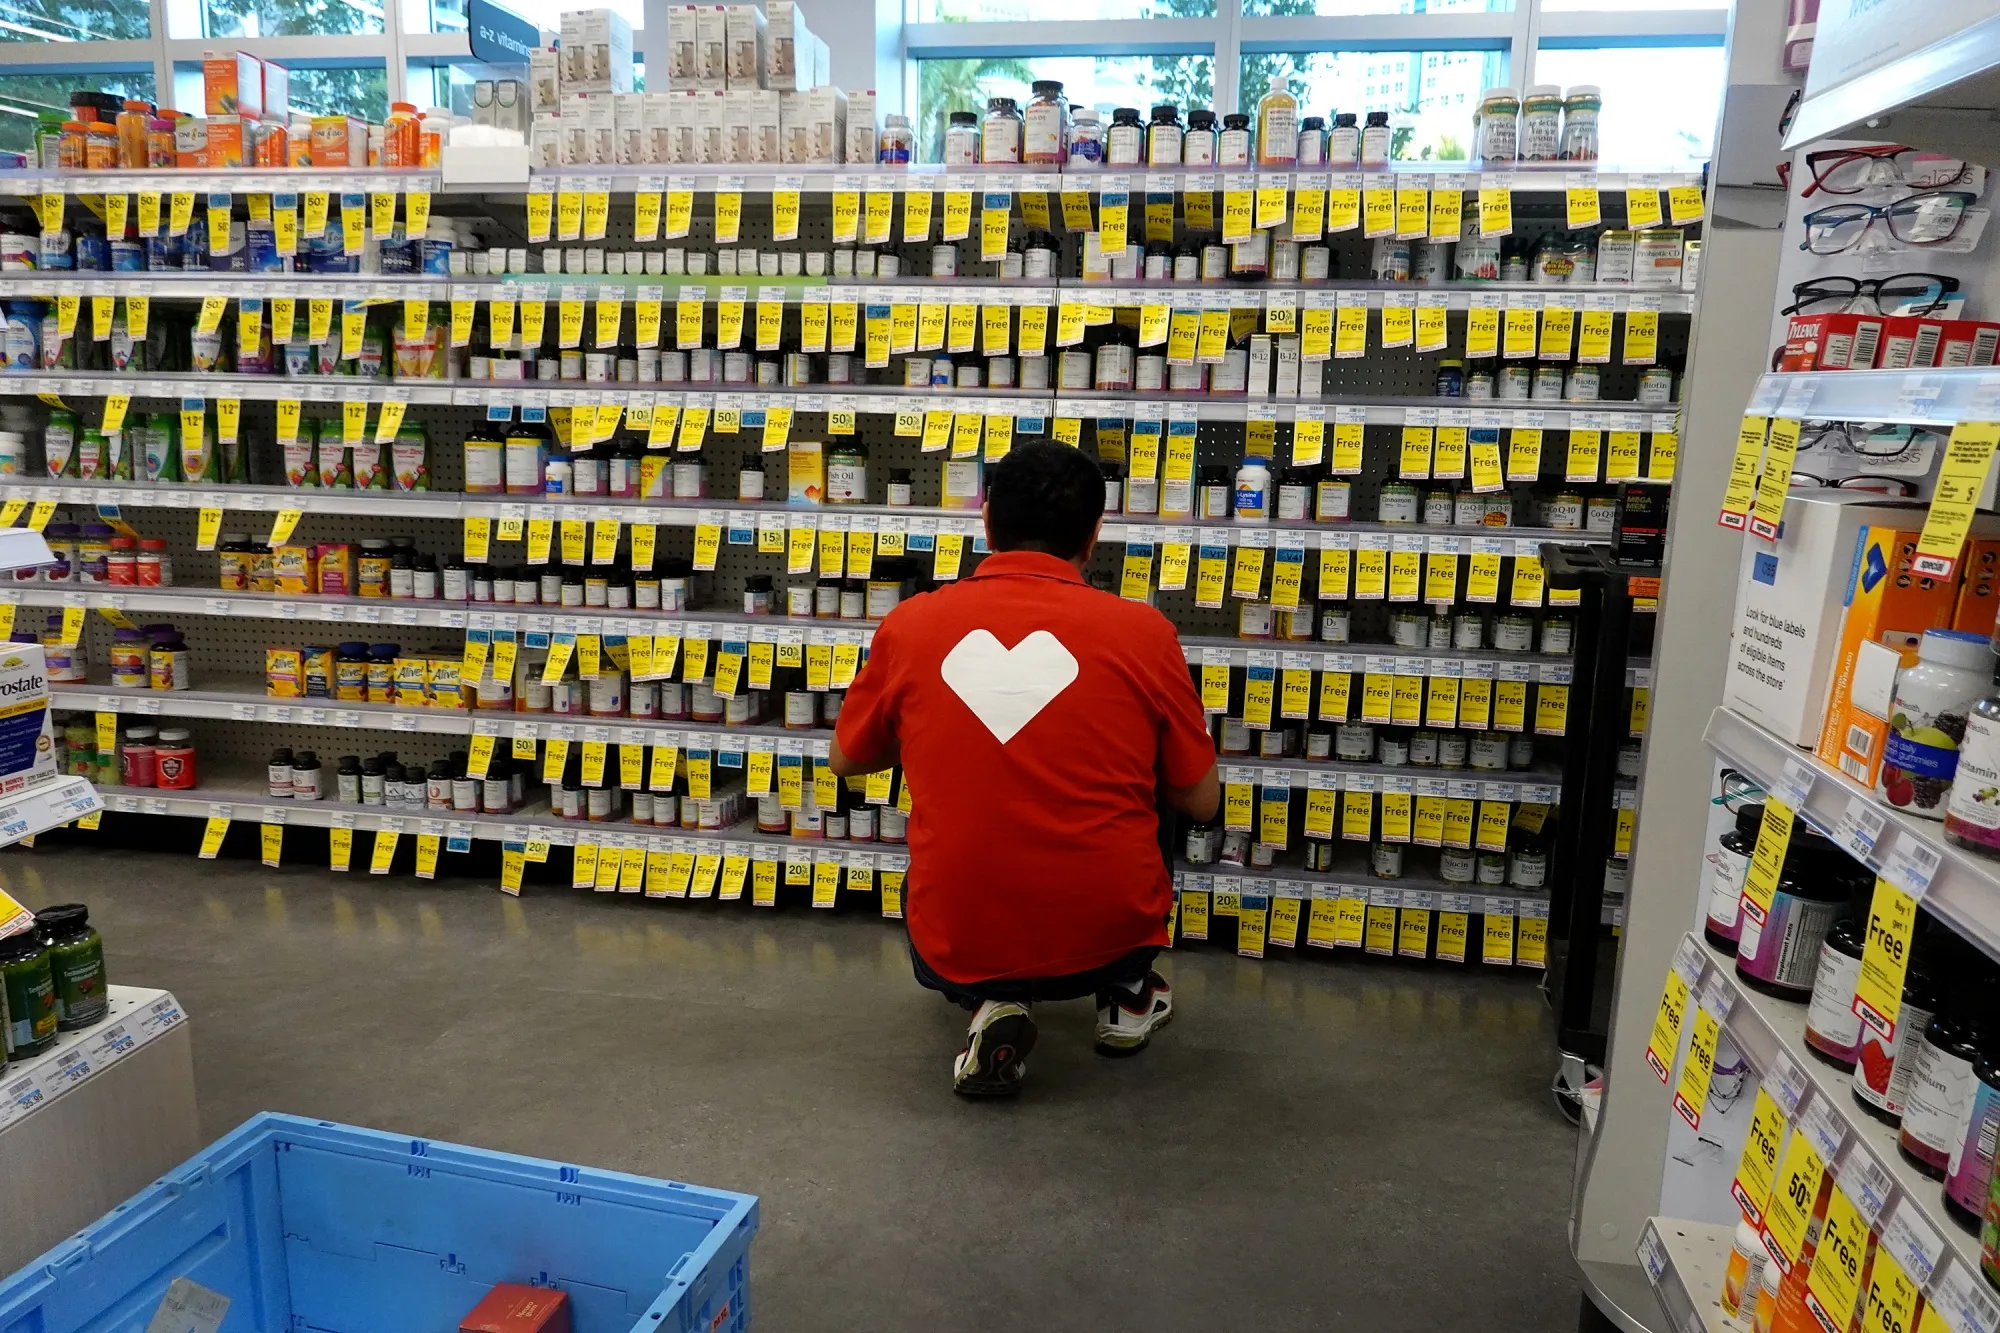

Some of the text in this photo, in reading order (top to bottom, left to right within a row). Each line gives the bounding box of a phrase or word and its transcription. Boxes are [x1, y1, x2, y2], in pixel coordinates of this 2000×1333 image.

[480, 25, 494, 42] a-z
[1332, 200, 1357, 210] Free
[1434, 204, 1459, 215] Free
[530, 206, 550, 217] Free
[718, 206, 739, 217] Free
[984, 223, 1006, 234] Free
[638, 314, 659, 324] Free
[1022, 319, 1045, 330] Free
[1305, 323, 1330, 334] Free
[1544, 320, 1570, 332] Free
[1790, 322, 1822, 340] TYLENOL
[868, 332, 889, 342] Free
[1280, 352, 1298, 360] B-12
[1541, 379, 1562, 388] Biotin
[1576, 377, 1598, 386] Biotin
[1644, 381, 1668, 390] Biotin
[684, 419, 705, 429] Free
[1133, 447, 1156, 458] Free
[1473, 457, 1498, 467] Free
[841, 471, 854, 480] Oil
[1426, 503, 1451, 512] Co Q-10
[1460, 503, 1470, 511] Co
[1558, 505, 1576, 514] Q-10
[1756, 522, 1772, 535] special
[530, 531, 550, 541] Free
[791, 540, 812, 550] Free
[277, 553, 302, 567] Alive!
[1920, 559, 1945, 572] special
[1472, 565, 1497, 577] Free
[1275, 575, 1298, 587] Free
[1746, 605, 1806, 638] Look for blue labels
[1743, 625, 1782, 650] and hundreds
[466, 652, 484, 665] Free
[1740, 642, 1785, 672] of eligible items
[270, 658, 296, 670] Alive!
[398, 666, 424, 680] Alive!
[432, 668, 460, 680] Alive!
[1738, 661, 1754, 678] across
[1756, 669, 1765, 682] the
[0, 675, 43, 696] rostate
[1247, 693, 1270, 704] Free
[1431, 690, 1455, 702] Free
[472, 746, 490, 757] Free
[1900, 752, 1939, 768] gummies
[750, 763, 770, 774] Free
[6, 776, 24, 786] MONTH
[37, 770, 55, 780] TABLETS
[6, 782, 24, 792] SUPPLY
[1309, 802, 1332, 814] Free
[1481, 813, 1506, 826] Free
[624, 859, 643, 869] Free
[816, 874, 836, 884] Free
[1745, 901, 1761, 918] special
[1895, 899, 1911, 917] Buy 1
[1339, 910, 1362, 922] Free
[1892, 920, 1908, 934] get 1
[1869, 914, 1903, 960] Free
[1777, 922, 1794, 980] Supplement Facts
[1661, 993, 1680, 1029] Free
[1862, 1006, 1886, 1031] special
[1690, 1032, 1710, 1070] Free
[1651, 1058, 1663, 1076] special
[1680, 1102, 1694, 1120] special
[1770, 1112, 1779, 1128] Buy
[1750, 1116, 1776, 1164] Free
[1768, 1128, 1776, 1142] get
[1806, 1156, 1820, 1176] Buy 1
[1802, 1171, 1811, 1186] get
[1739, 1190, 1756, 1218] special
[1850, 1217, 1864, 1242] Buy 1
[1824, 1218, 1857, 1278] Free
[1848, 1236, 1861, 1256] get 1
[1767, 1237, 1786, 1268] special
[1894, 1277, 1912, 1302] Buy 1
[1892, 1298, 1908, 1318] get 1
[1812, 1302, 1836, 1333] special
